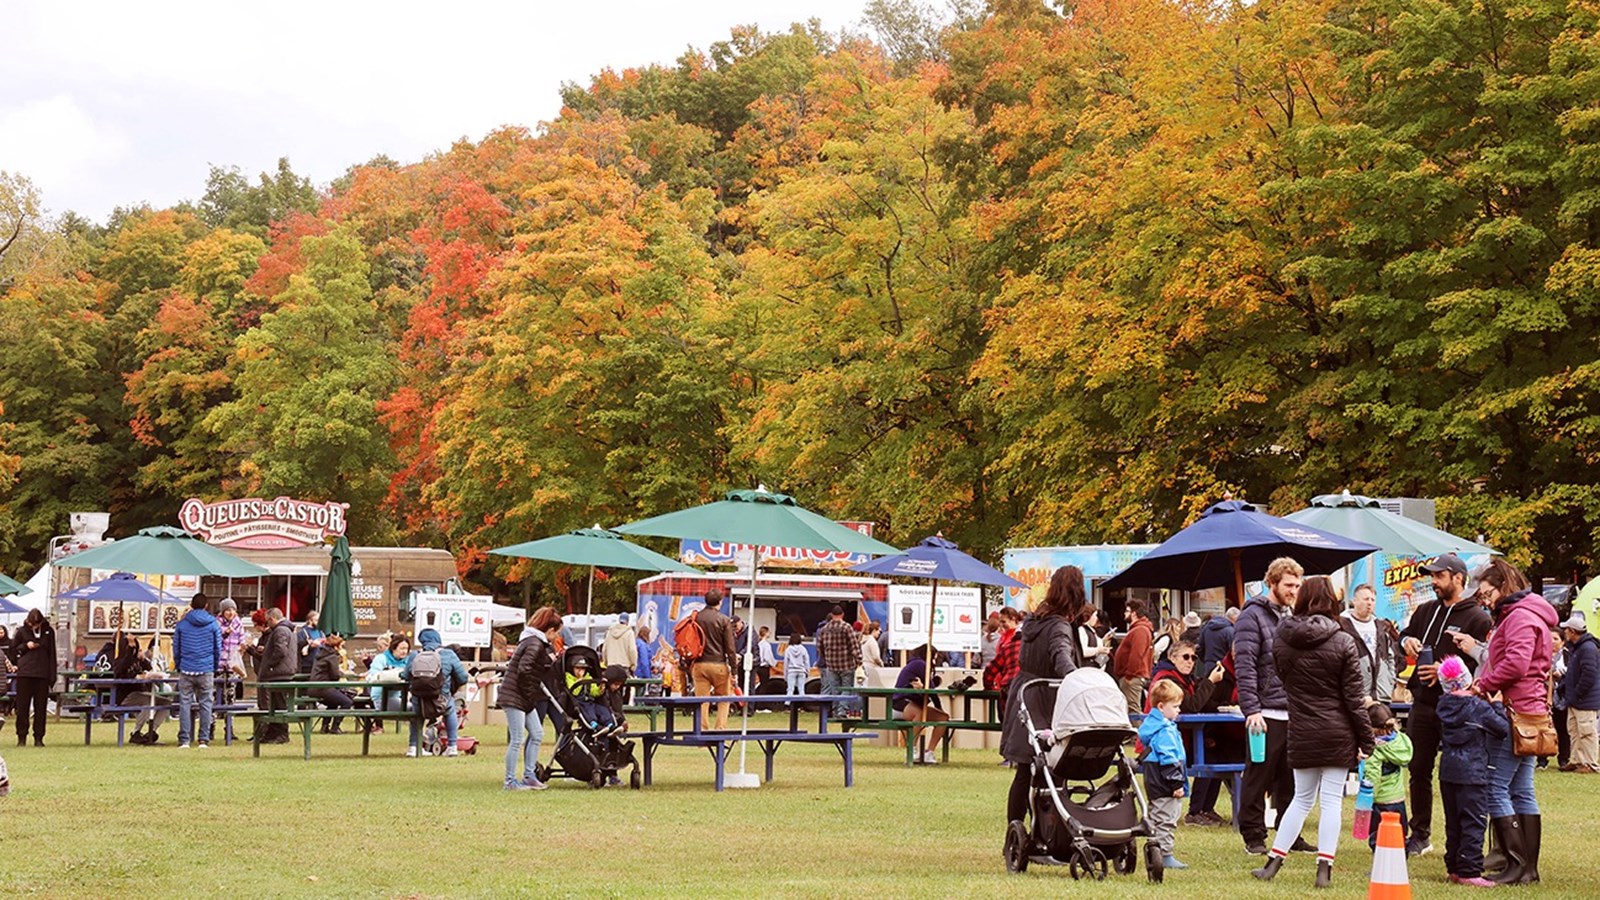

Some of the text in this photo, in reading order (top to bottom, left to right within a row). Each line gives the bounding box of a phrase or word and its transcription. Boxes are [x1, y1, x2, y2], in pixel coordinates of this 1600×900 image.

[184, 499, 344, 533] QUEUES DE CASTOR
[214, 530, 239, 541] POUTINE
[286, 527, 319, 541] SMOOTHIES
[1384, 557, 1435, 586] EXPLO
